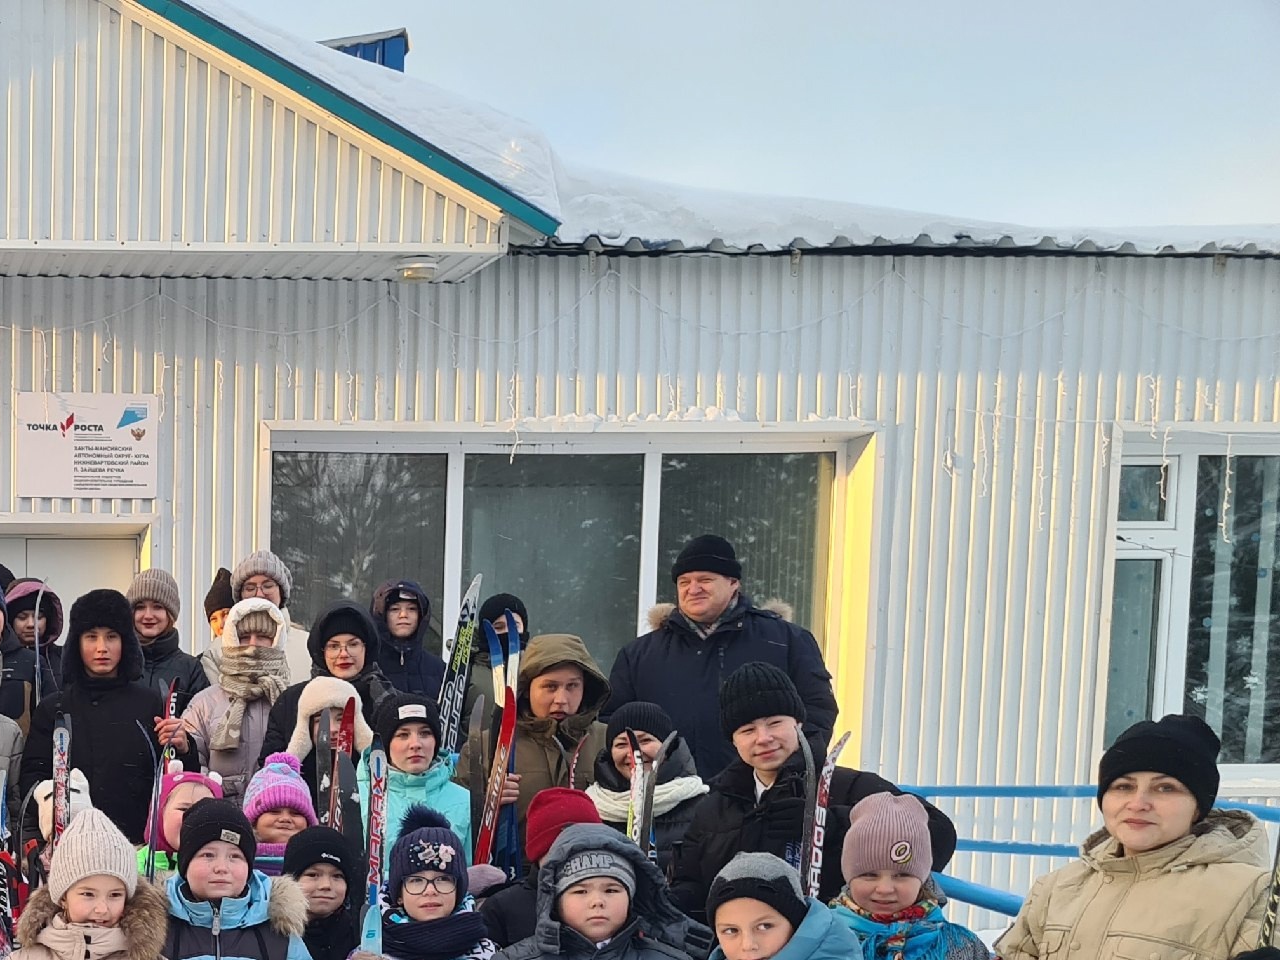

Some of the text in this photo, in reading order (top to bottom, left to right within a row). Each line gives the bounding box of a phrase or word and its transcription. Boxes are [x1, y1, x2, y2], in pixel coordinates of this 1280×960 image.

[26, 423, 104, 432] ТОЧКА РОСТА
[452, 625, 468, 673] FISCHER
[370, 772, 383, 885] MARAX
[810, 806, 827, 898] RADOS
[563, 853, 613, 876] CHAMP
